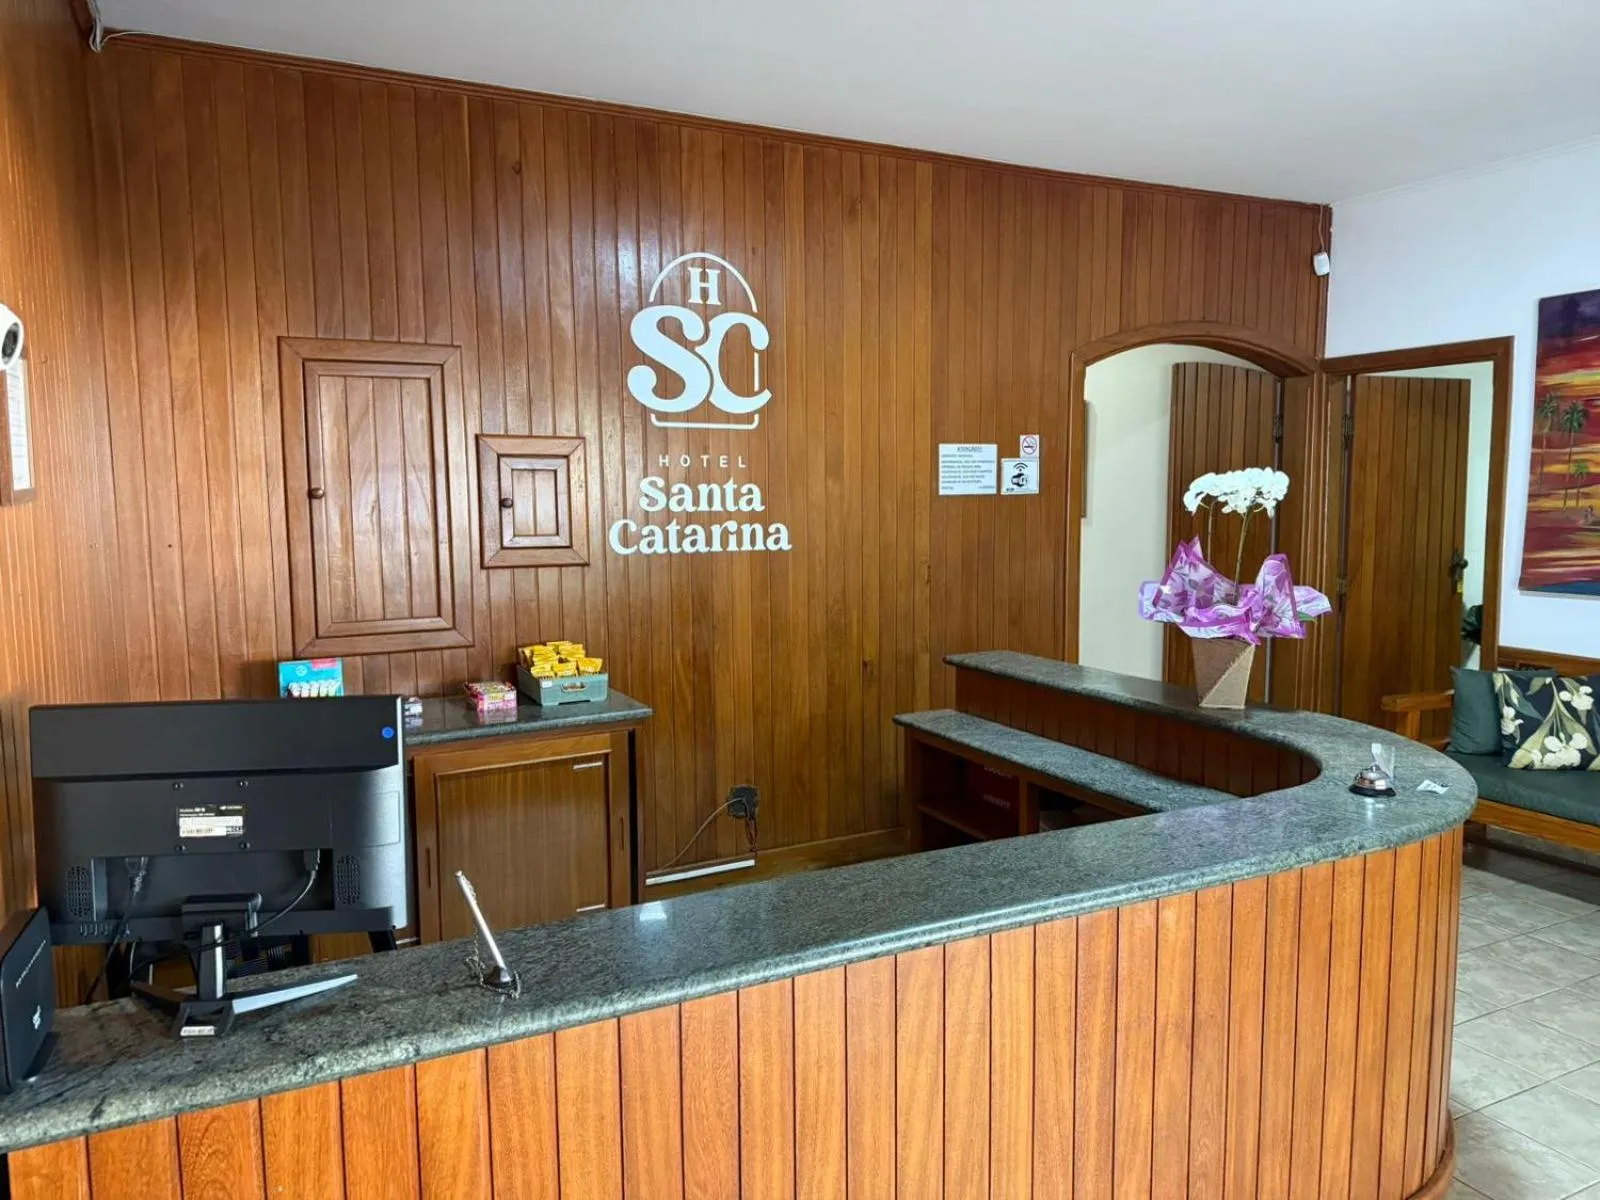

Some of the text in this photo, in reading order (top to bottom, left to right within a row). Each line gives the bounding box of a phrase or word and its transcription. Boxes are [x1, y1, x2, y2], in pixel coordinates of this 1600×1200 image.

[688, 267, 721, 305] H
[627, 305, 772, 414] SC
[658, 455, 747, 468] HOTEL
[638, 476, 765, 512] Santa
[608, 518, 792, 555] Catarina
